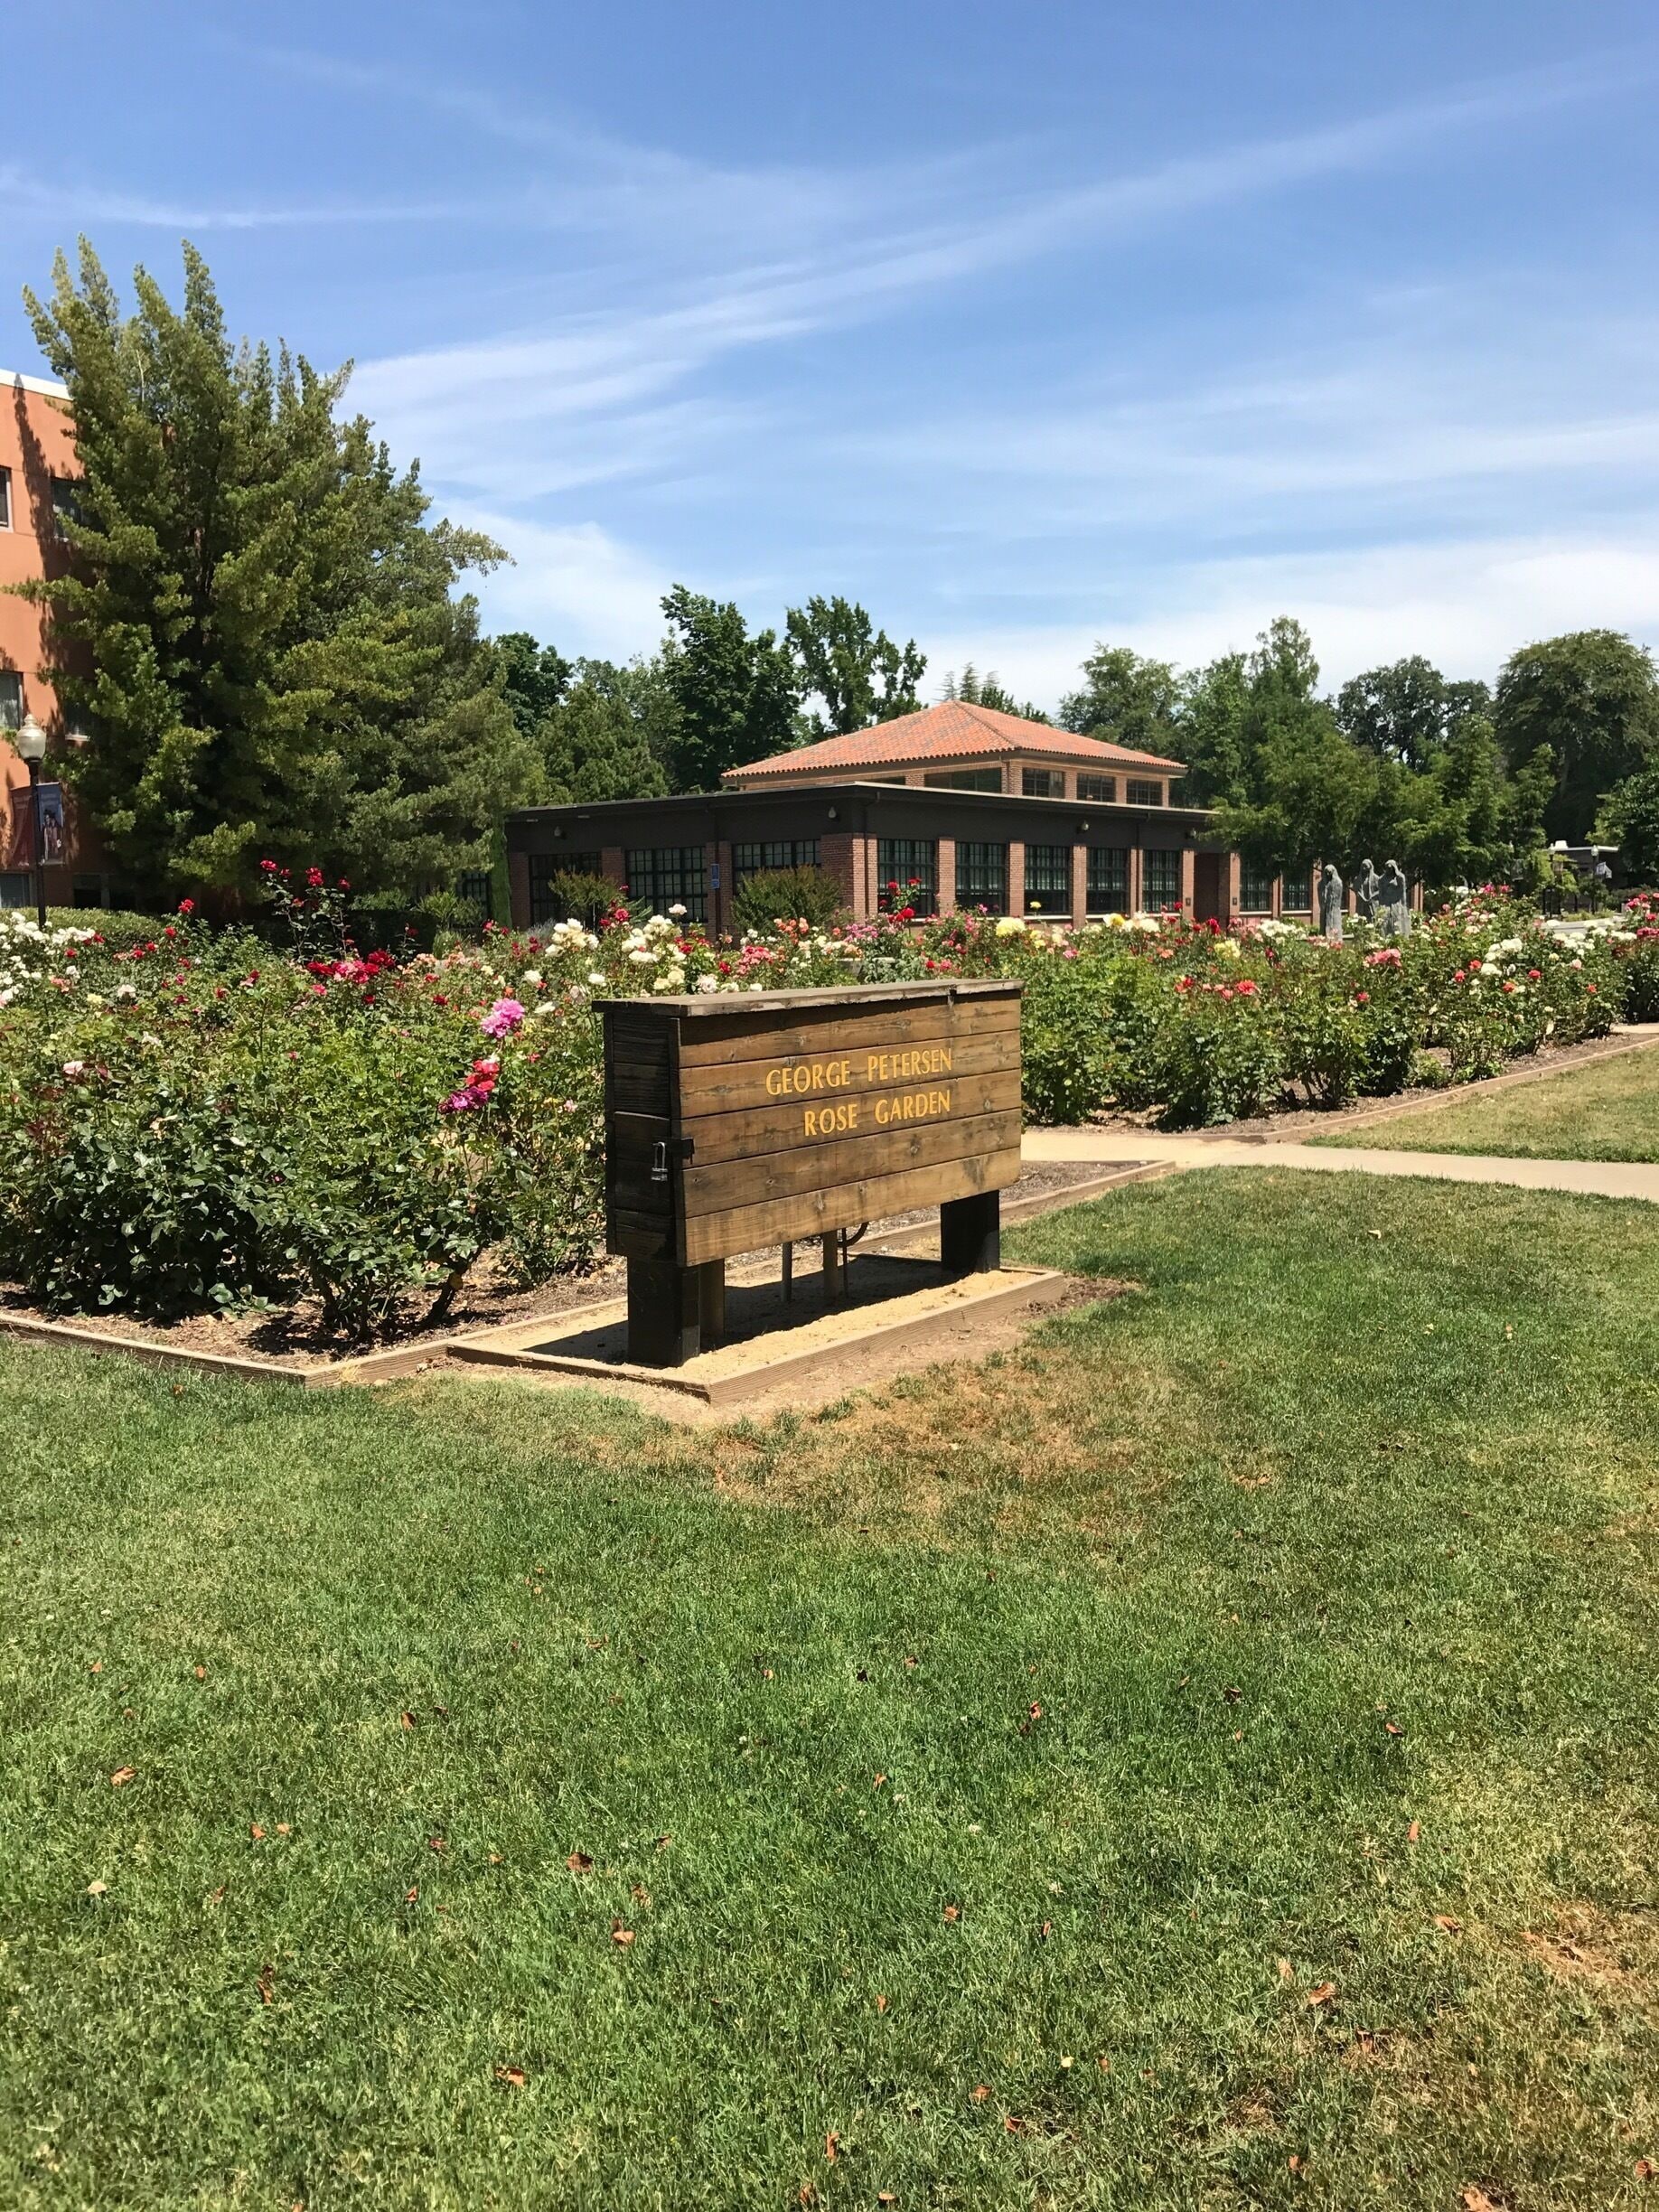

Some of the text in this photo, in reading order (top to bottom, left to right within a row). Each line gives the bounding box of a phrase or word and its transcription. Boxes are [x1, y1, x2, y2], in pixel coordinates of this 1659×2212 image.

[765, 1048, 951, 1096] GEORGE PETERSEN
[804, 1090, 951, 1137] ROSE GARDEN
